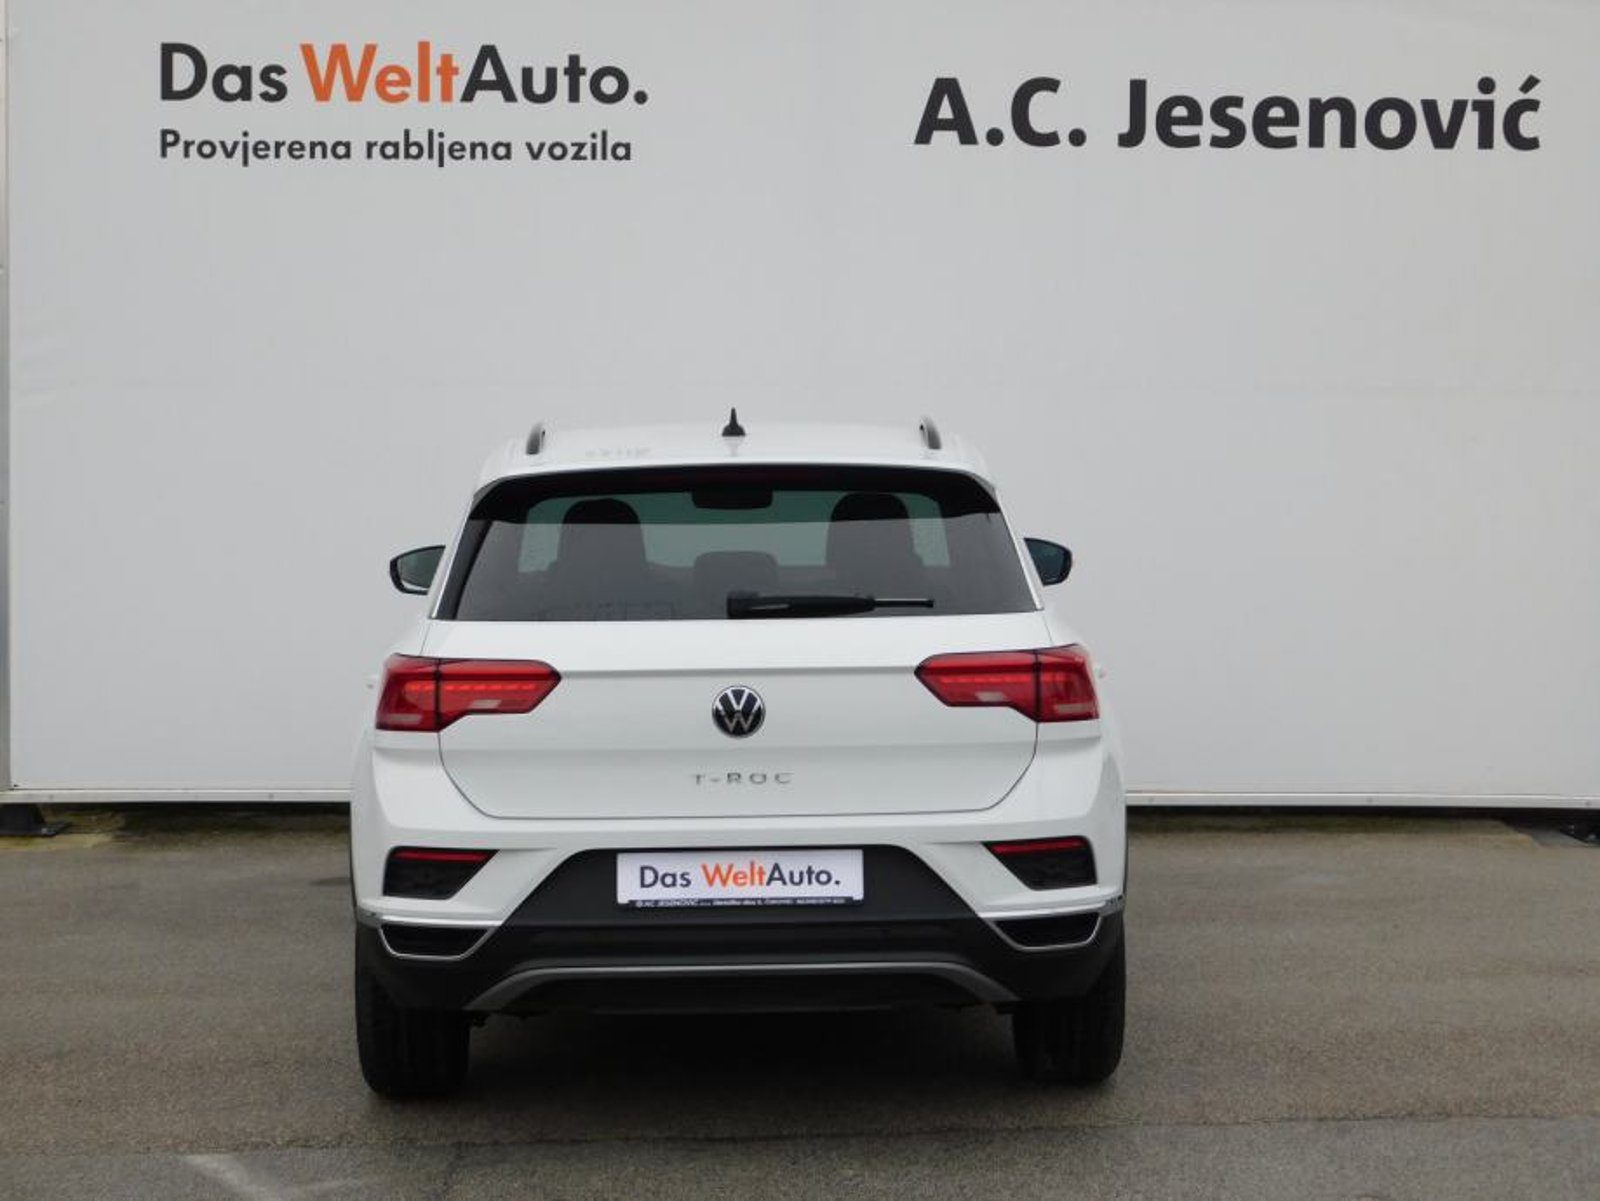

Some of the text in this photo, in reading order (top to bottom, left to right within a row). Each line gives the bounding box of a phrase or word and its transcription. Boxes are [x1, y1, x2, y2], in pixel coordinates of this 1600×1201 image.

[161, 40, 649, 105] Das WeltAuto.
[913, 74, 1542, 151] A.C. Jesenović
[160, 128, 632, 168] Provjerena rabljena vozila
[692, 771, 794, 786] T-ROC
[639, 861, 841, 889] Das WeltAuto.
